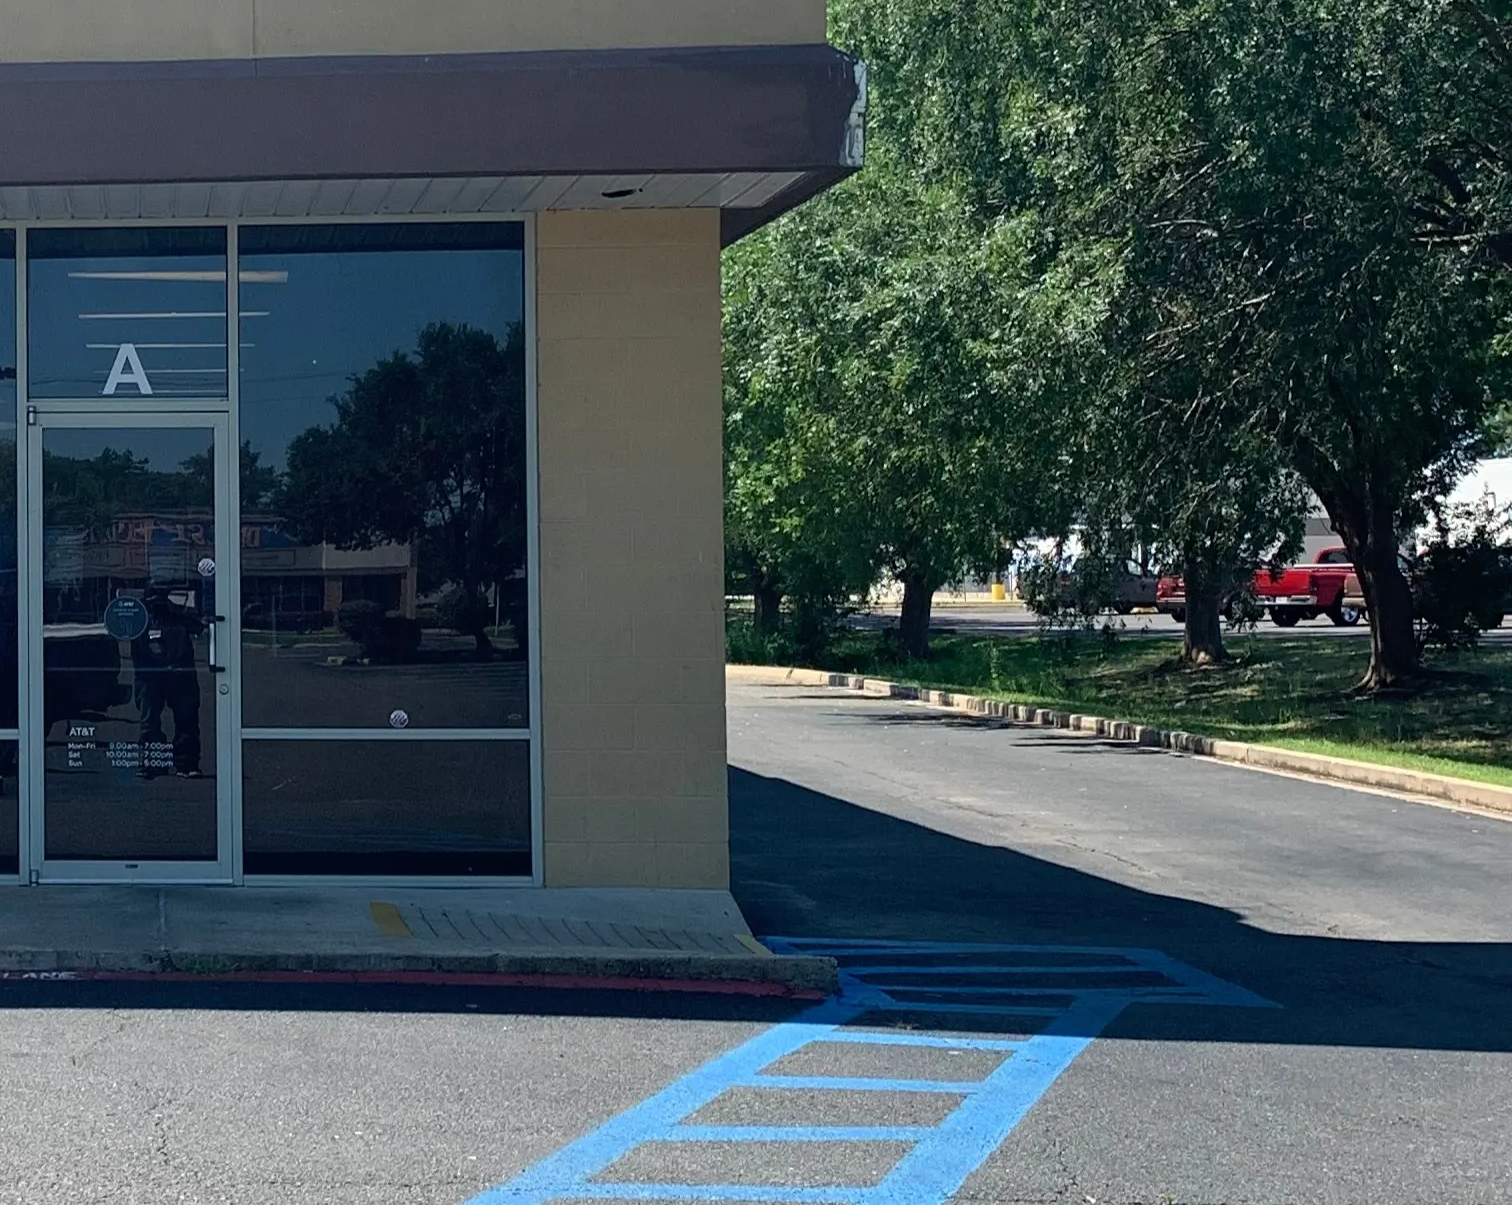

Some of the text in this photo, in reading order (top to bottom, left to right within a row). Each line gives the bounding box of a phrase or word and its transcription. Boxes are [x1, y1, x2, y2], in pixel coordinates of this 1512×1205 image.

[102, 343, 153, 394] A
[69, 727, 95, 736] AT&T
[68, 751, 80, 759] Sat
[68, 759, 83, 767] Sun
